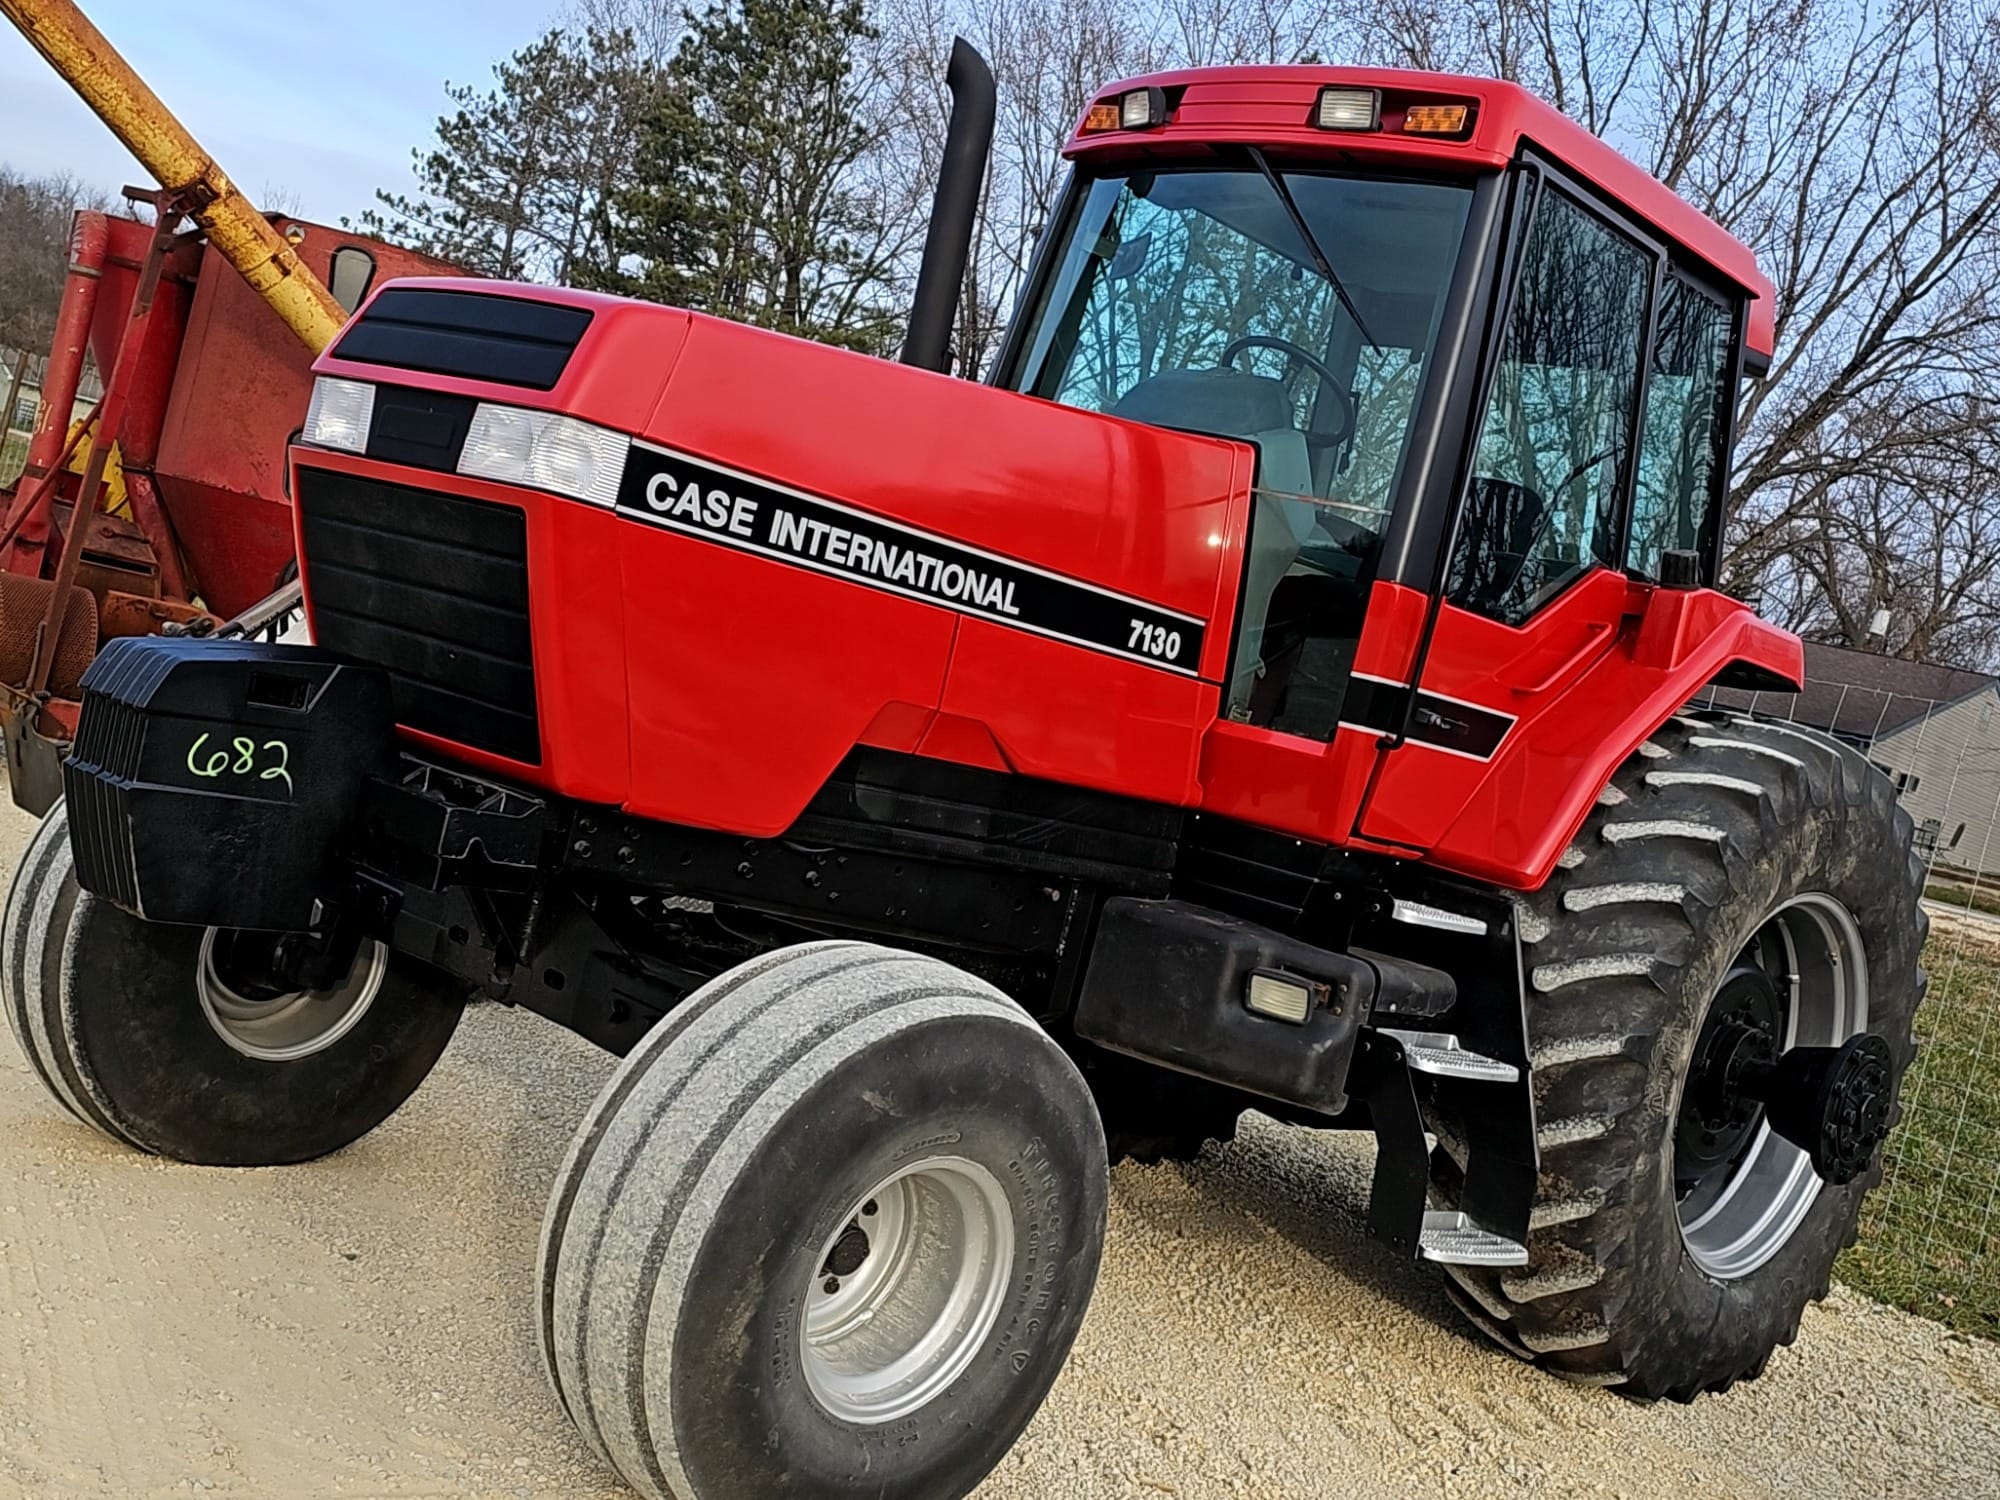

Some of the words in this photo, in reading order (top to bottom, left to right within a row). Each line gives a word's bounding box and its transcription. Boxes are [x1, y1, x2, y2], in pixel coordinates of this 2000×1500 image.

[646, 473, 759, 537] CASE
[769, 509, 1020, 615] INTERNATIONAL
[1127, 619, 1181, 660] 7130
[187, 732, 293, 798] 682
